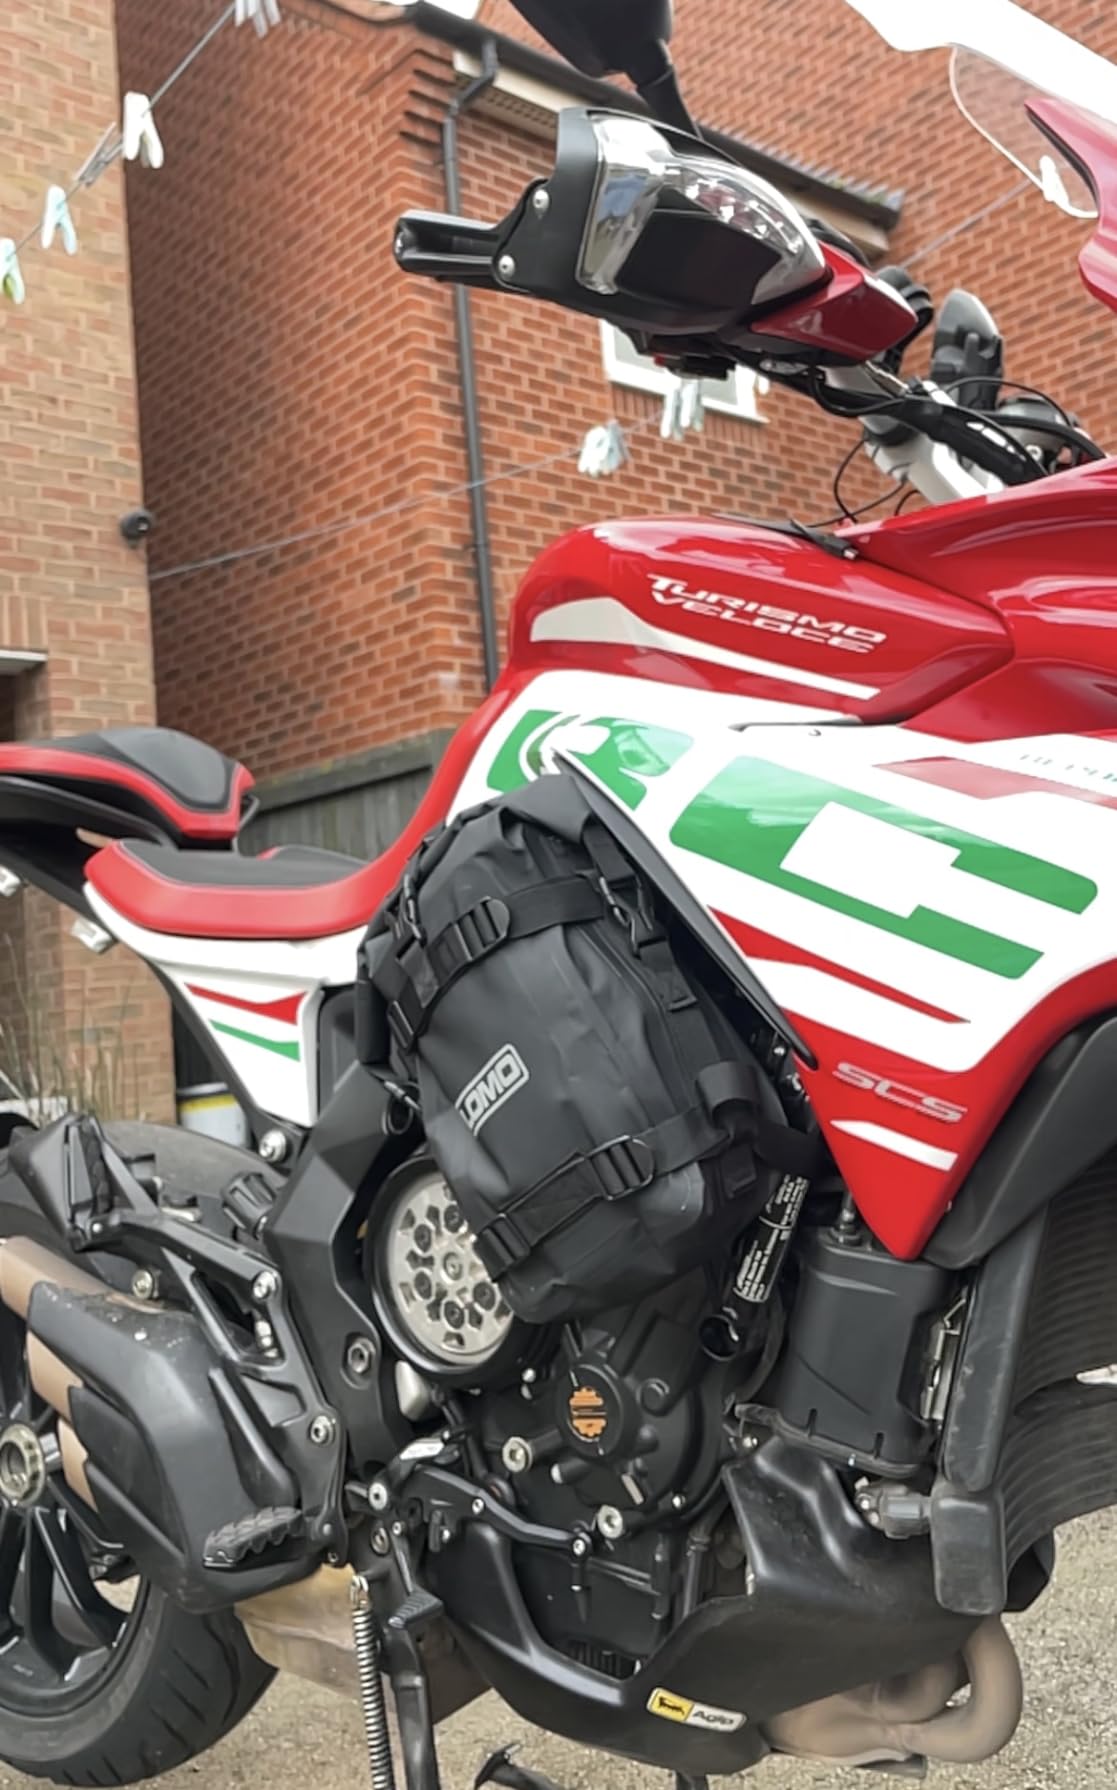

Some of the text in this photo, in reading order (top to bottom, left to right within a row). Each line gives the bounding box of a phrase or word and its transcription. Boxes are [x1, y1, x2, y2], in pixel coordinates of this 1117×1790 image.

[647, 573, 887, 643] TURISMO
[651, 591, 875, 653] VELOCE
[832, 1062, 968, 1122] SCS
